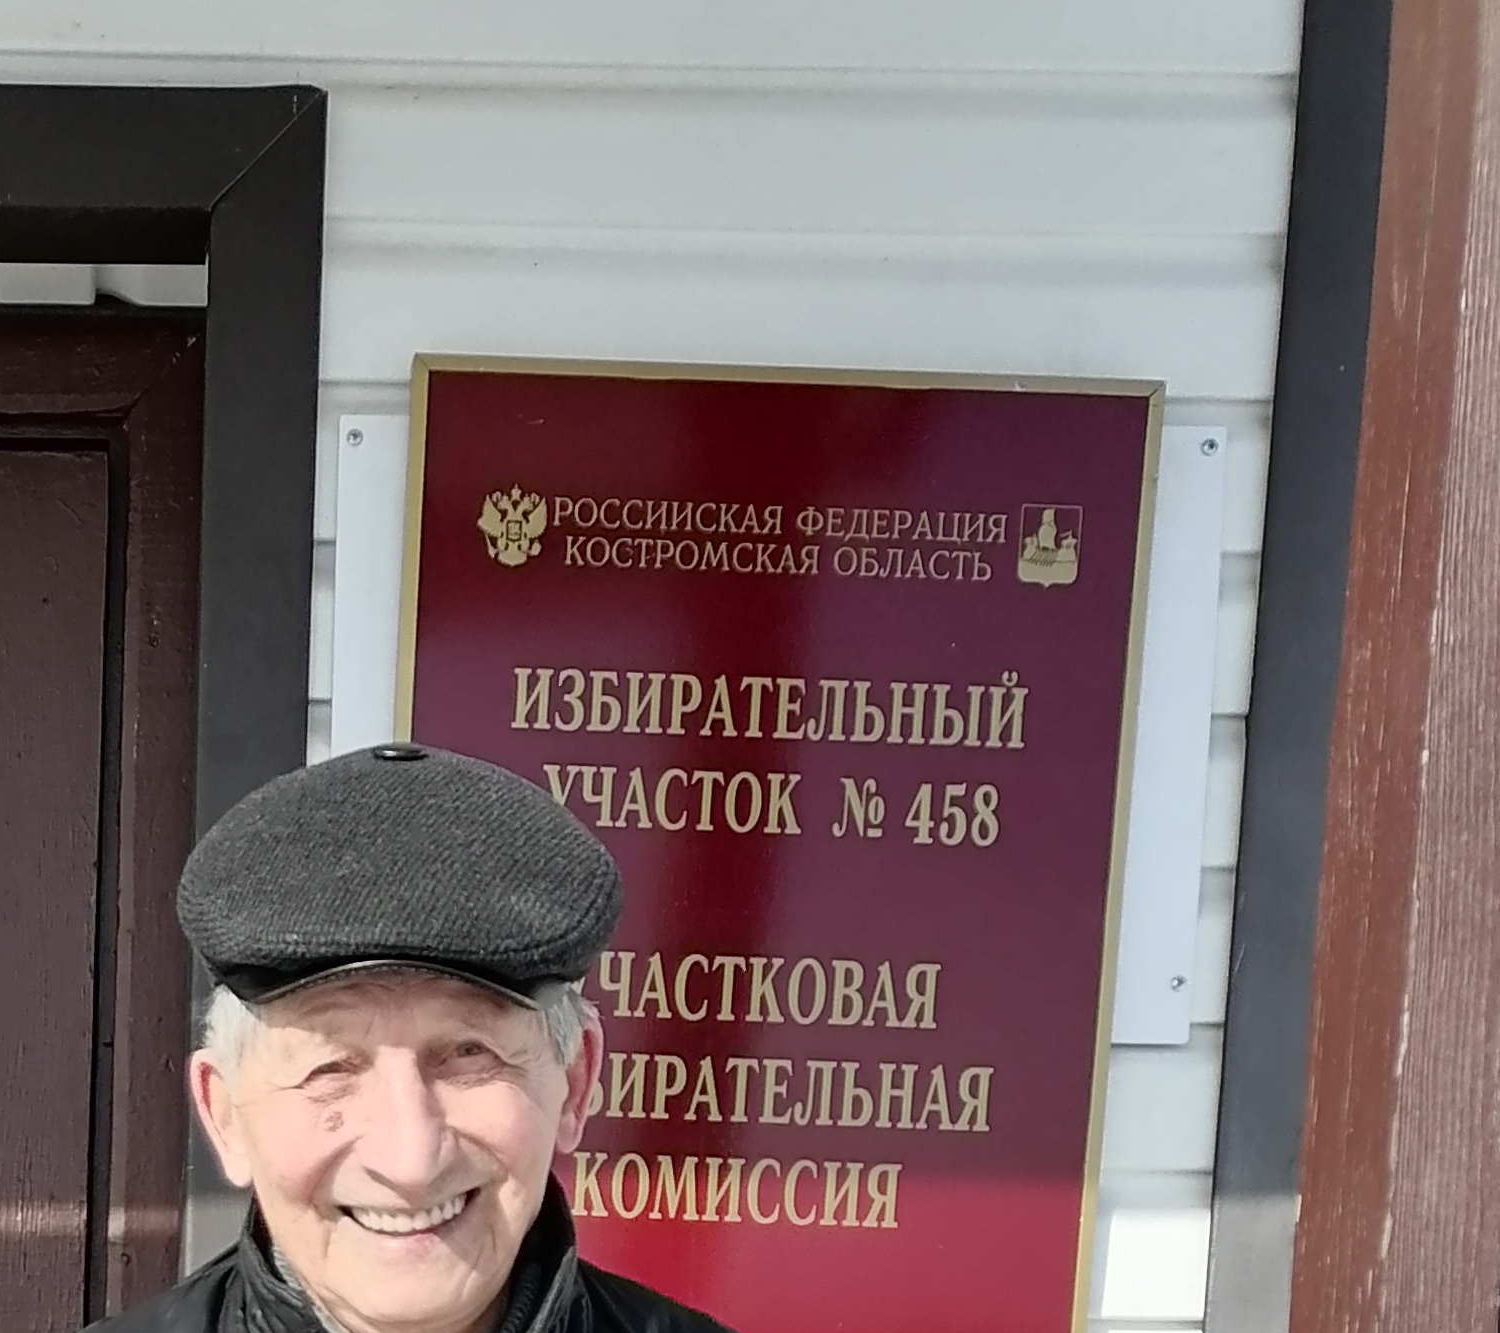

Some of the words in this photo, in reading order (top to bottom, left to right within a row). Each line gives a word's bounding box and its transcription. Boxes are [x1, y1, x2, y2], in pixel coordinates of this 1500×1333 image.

[564, 535, 821, 576] КОСТРОМСКАЯ
[833, 546, 992, 582] ОБЛАСТЬ
[797, 505, 1008, 544] ФЕДЕРАЦИЯ
[510, 667, 1029, 749] ИЗБИРАТЕЛЬНЫЙ
[542, 764, 802, 835] УЧАСТОК
[832, 776, 886, 839] №
[905, 782, 1000, 848] 458
[575, 951, 941, 1029] ЧАСТКОВАЯ
[571, 1151, 902, 1228] КОМИССИЯ
